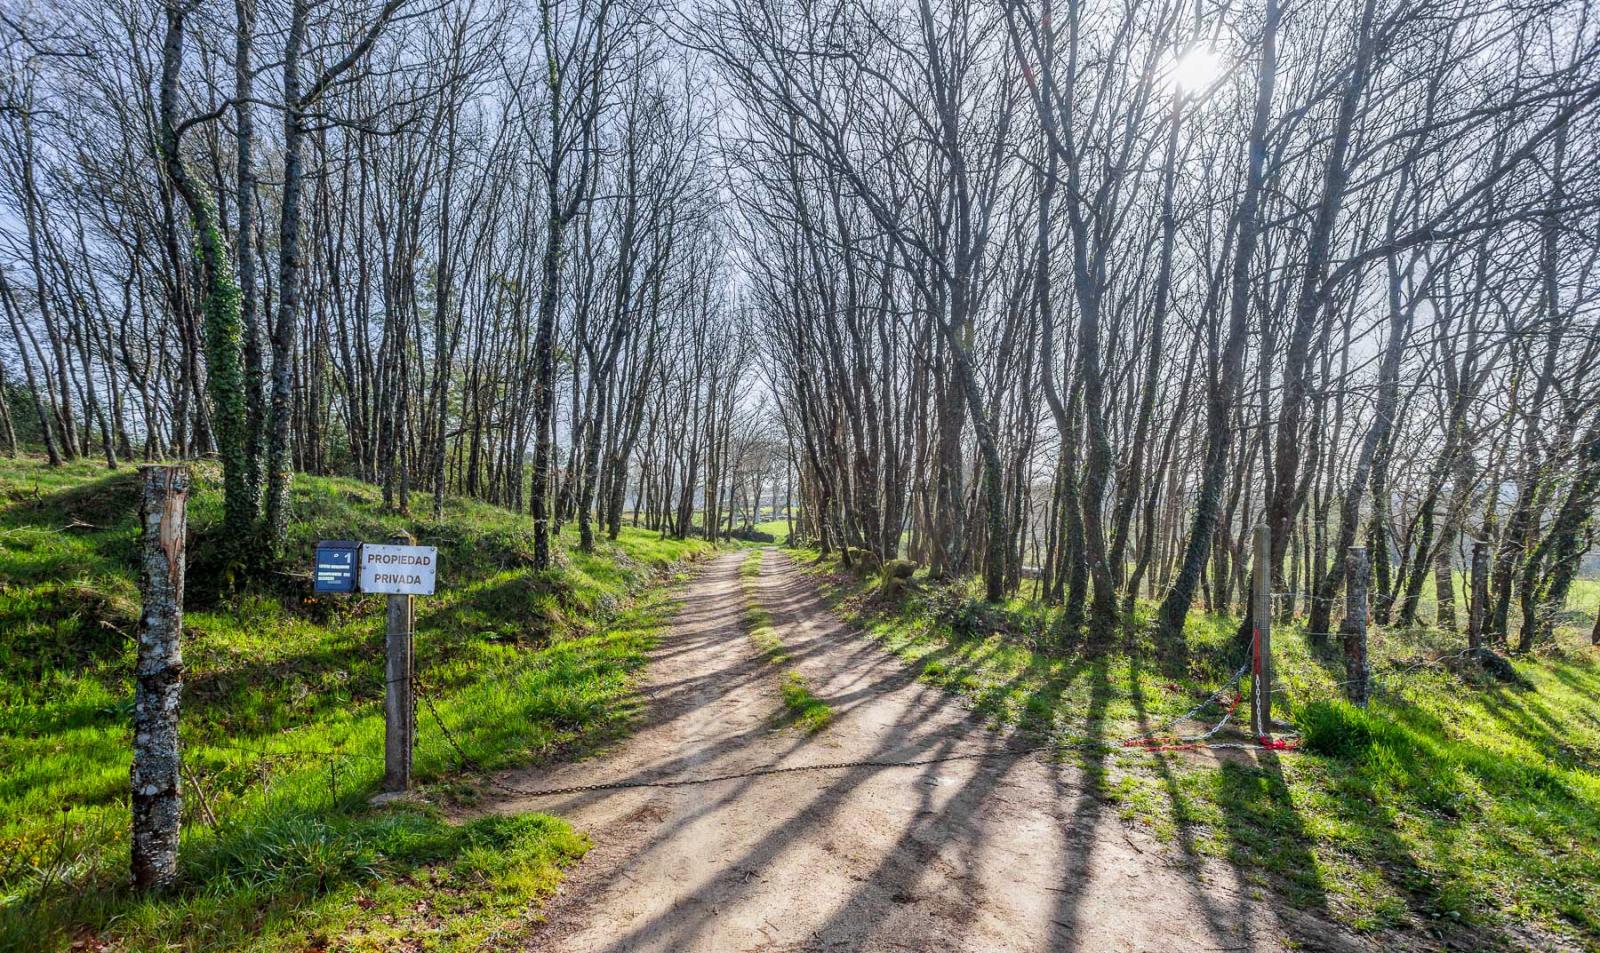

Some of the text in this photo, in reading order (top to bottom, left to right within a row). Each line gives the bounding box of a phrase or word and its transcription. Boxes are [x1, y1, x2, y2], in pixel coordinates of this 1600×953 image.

[344, 552, 351, 564] 1
[367, 553, 431, 566] PROPIEDAD
[374, 573, 421, 585] PRIVADA
